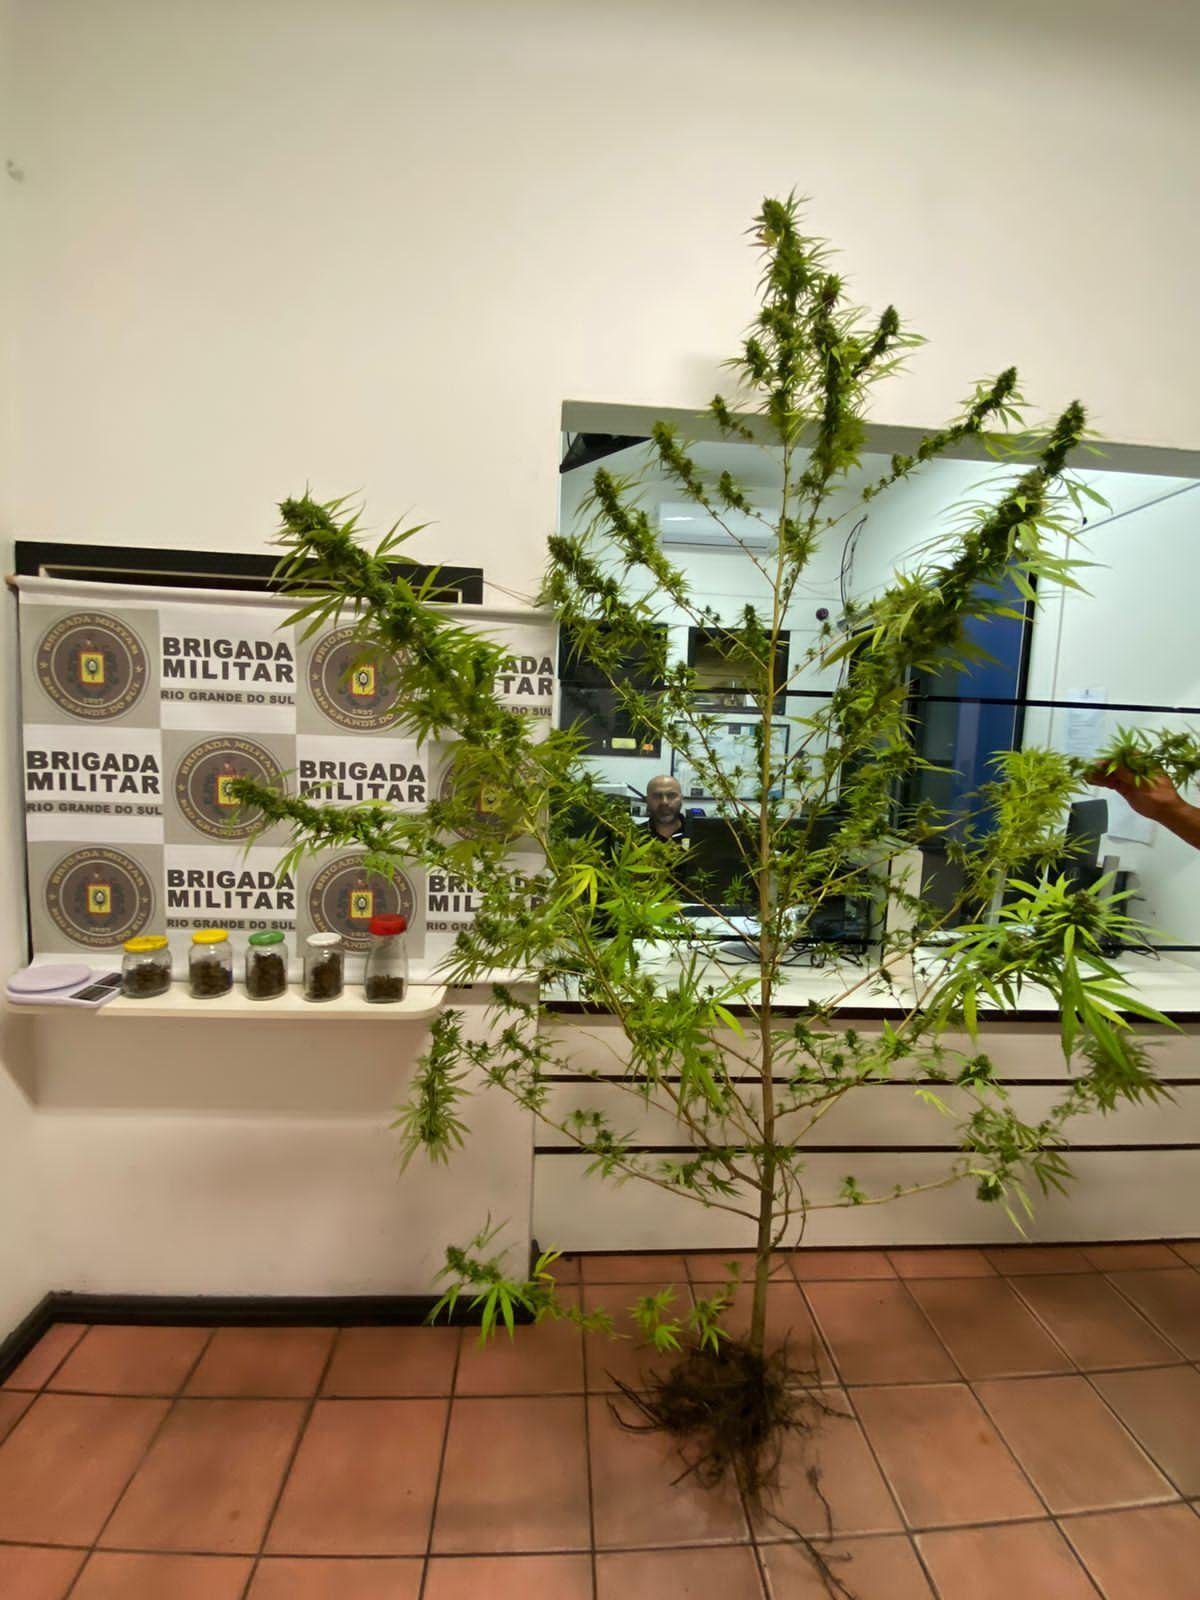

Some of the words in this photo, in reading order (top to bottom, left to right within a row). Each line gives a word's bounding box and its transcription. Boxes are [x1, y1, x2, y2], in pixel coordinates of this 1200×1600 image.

[163, 637, 293, 661] BRIGADA
[163, 659, 294, 683] MILITAR
[161, 690, 184, 700] RIO
[189, 692, 242, 703] GRANDE
[247, 694, 265, 704] DO
[270, 694, 295, 705] SUL
[511, 706, 528, 715] DO
[27, 750, 159, 773] BRIGADA
[300, 760, 426, 782] BRIGADA
[28, 772, 160, 794] MILITAR
[300, 781, 426, 803] MILITAR
[27, 802, 54, 813] RIO
[58, 803, 110, 814] GRANDE
[115, 804, 133, 814] DO
[137, 806, 162, 816] SUL
[168, 869, 295, 890] BRIGADA
[168, 889, 295, 910] MILITAR
[167, 918, 188, 928] RIO
[193, 919, 245, 929] GRANDE
[249, 920, 267, 929] DO
[271, 920, 296, 930] SUL
[426, 922, 447, 930] RIO
